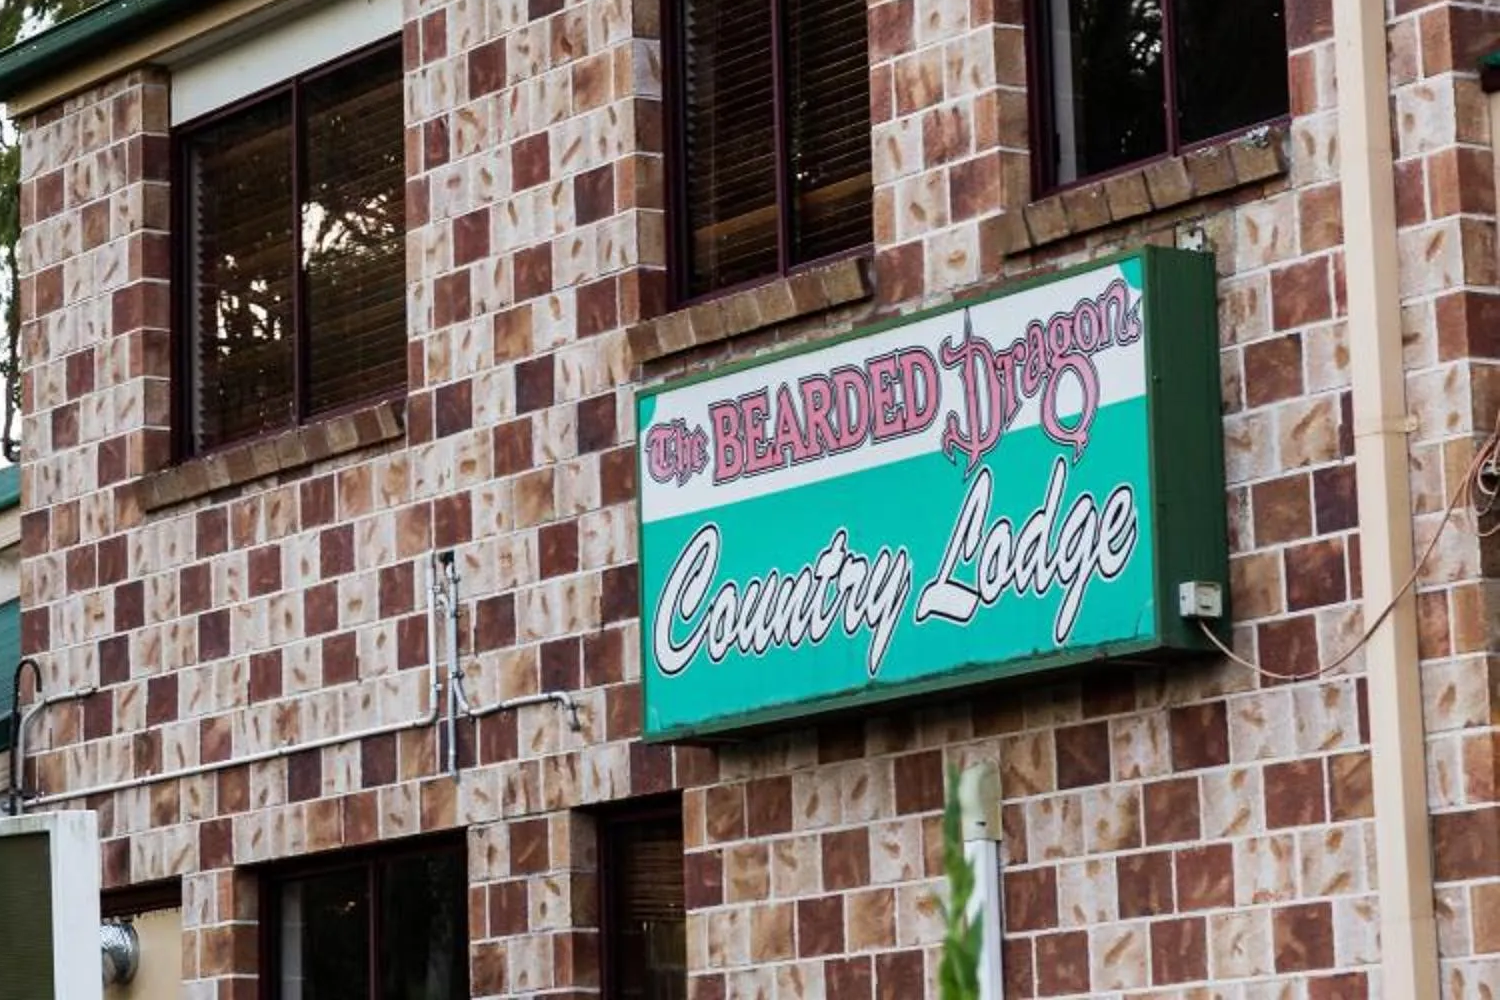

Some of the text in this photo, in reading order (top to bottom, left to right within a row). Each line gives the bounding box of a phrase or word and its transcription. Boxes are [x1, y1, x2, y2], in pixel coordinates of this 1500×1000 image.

[645, 278, 1143, 488] The BEARDED Dragon
[654, 456, 1139, 677] Country Lodge
